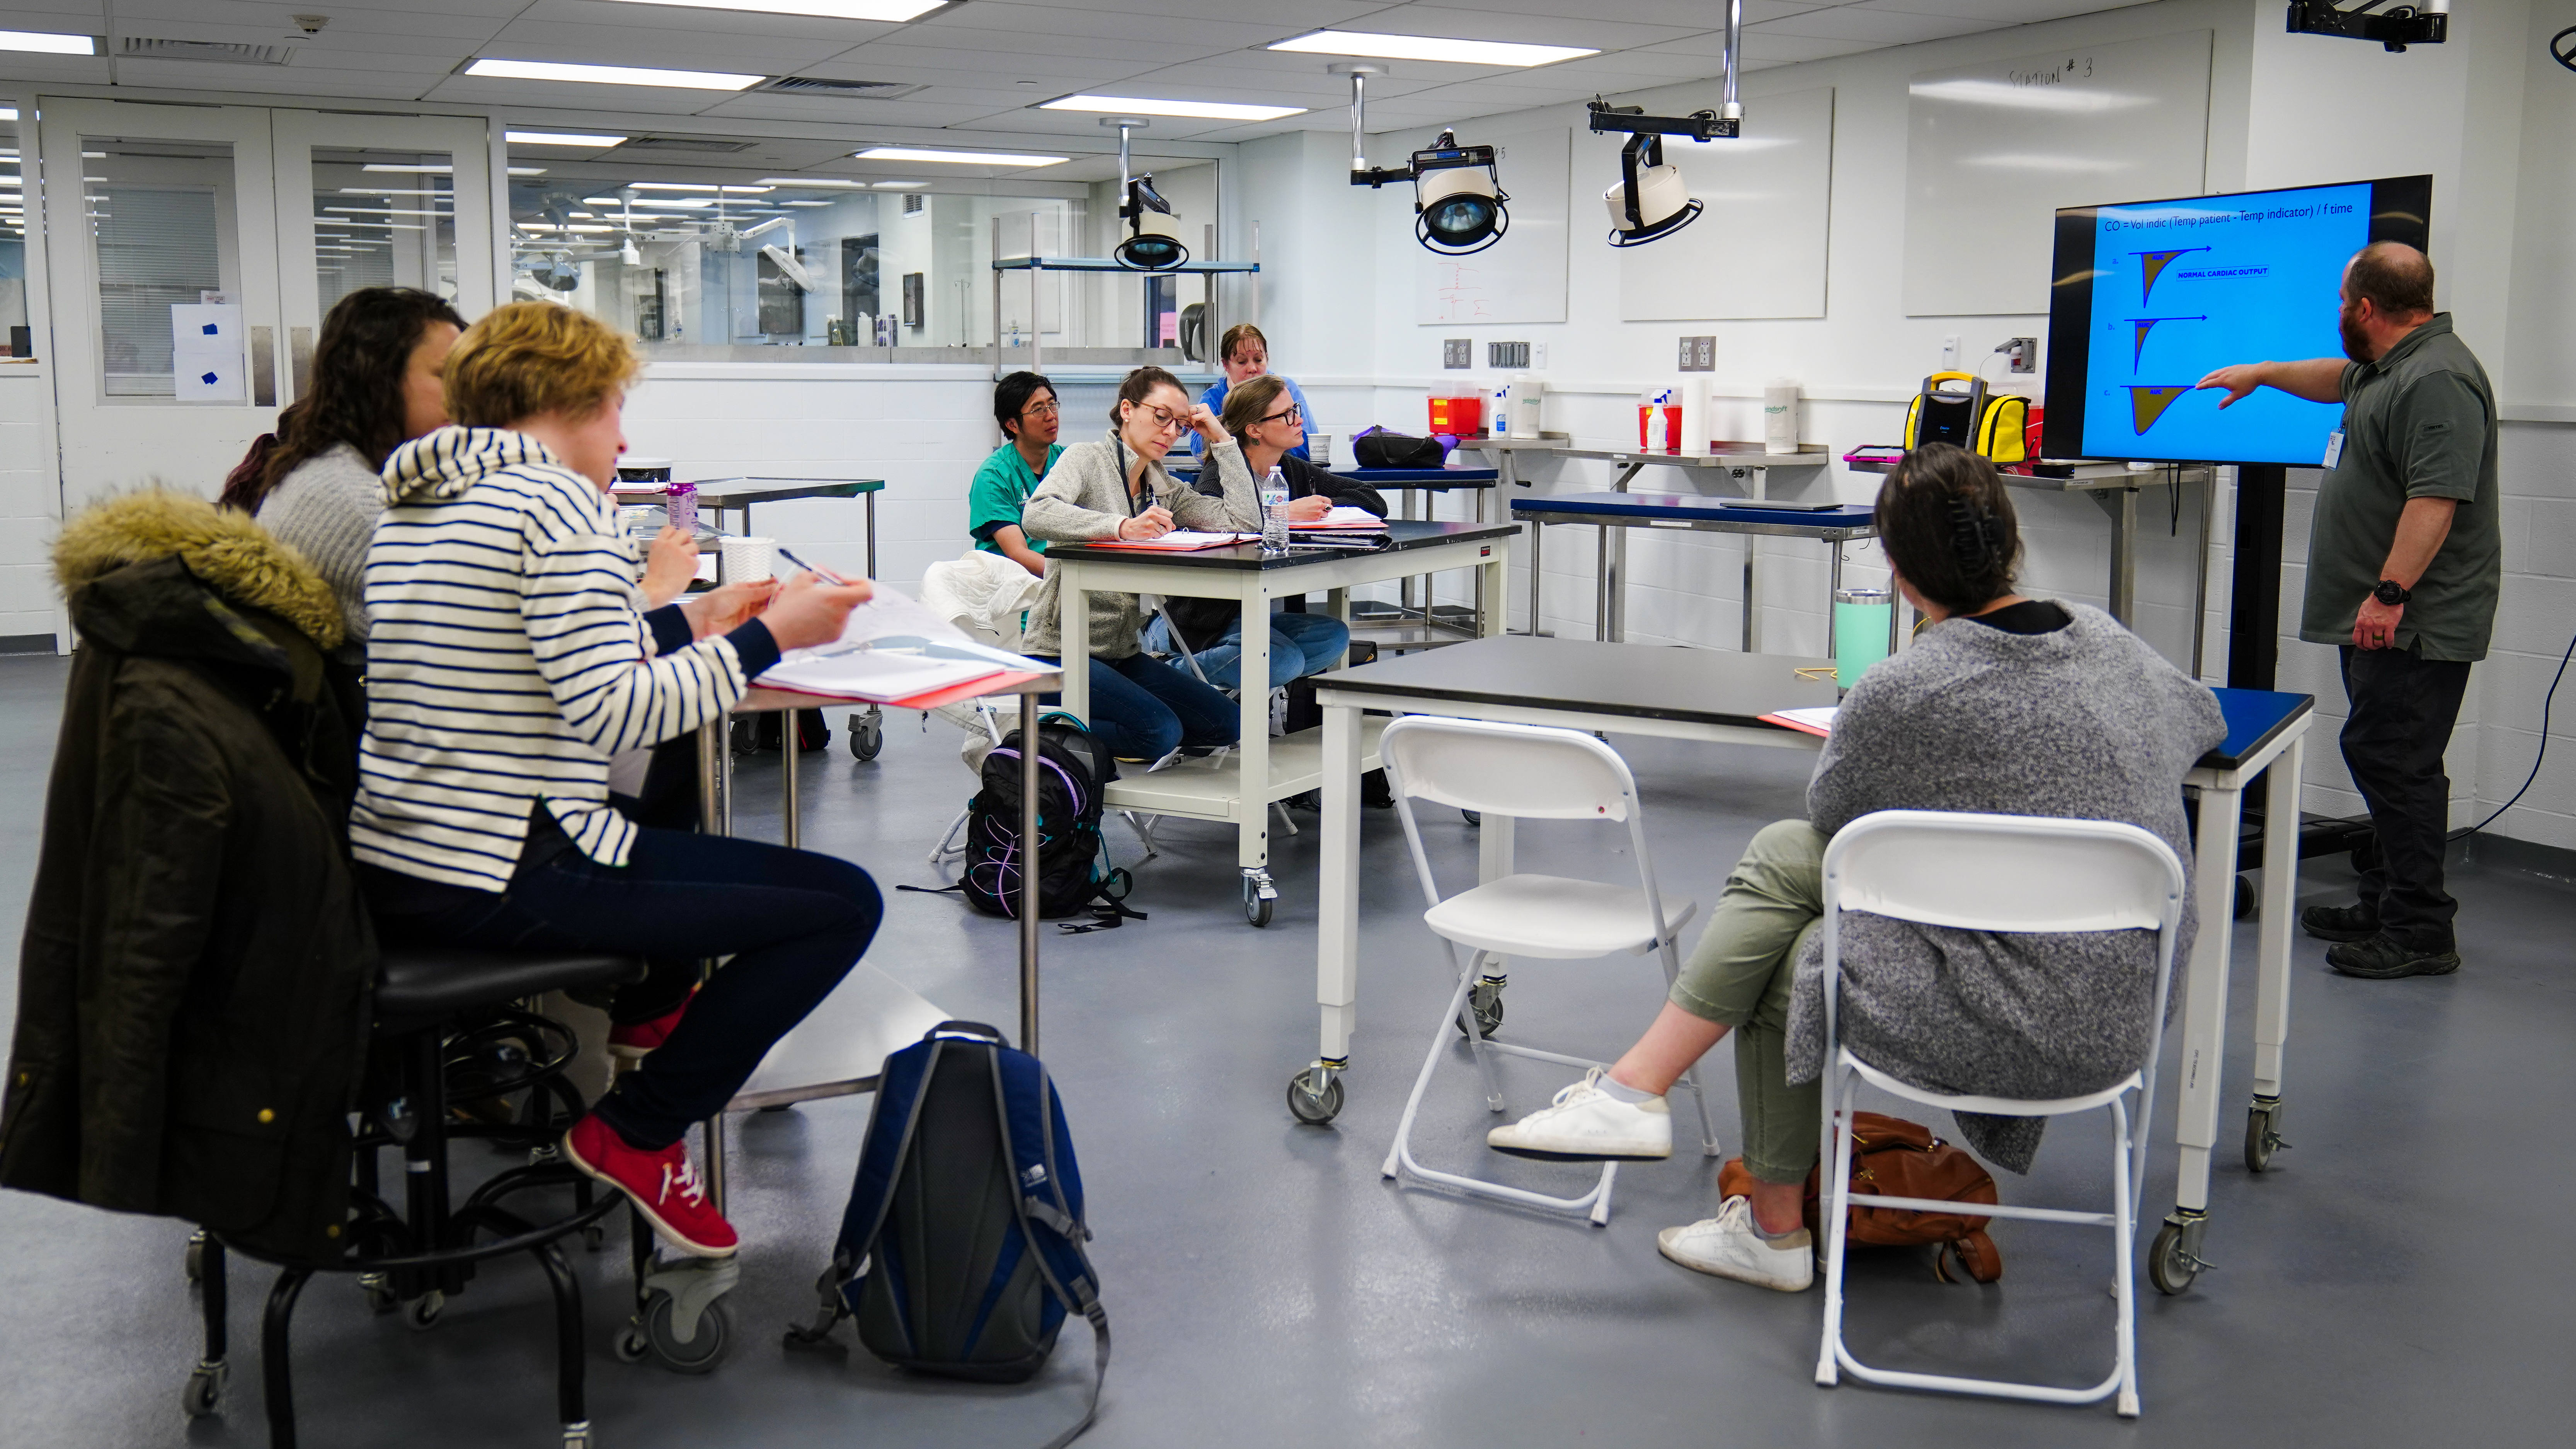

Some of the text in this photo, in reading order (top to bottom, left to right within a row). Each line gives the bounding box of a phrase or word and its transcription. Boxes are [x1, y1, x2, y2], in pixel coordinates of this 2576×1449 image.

[2009, 57, 2092, 89] STATION # 3
[1740, 106, 1746, 122] 4
[1502, 147, 1505, 159] 5
[2105, 221, 2120, 231] CO
[2131, 219, 2143, 229] Vol
[2147, 218, 2166, 228] indic
[2169, 216, 2196, 230] (Temp
[2199, 213, 2230, 227] patient
[2239, 210, 2264, 223] Temp
[2268, 205, 2313, 219] indicator)
[2316, 204, 2321, 215] /
[2324, 203, 2328, 215] f
[2330, 203, 2353, 214] time
[2178, 271, 2206, 279] NORMAL
[2239, 268, 2268, 276] OUTPUT
[2108, 322, 2115, 331] b.
